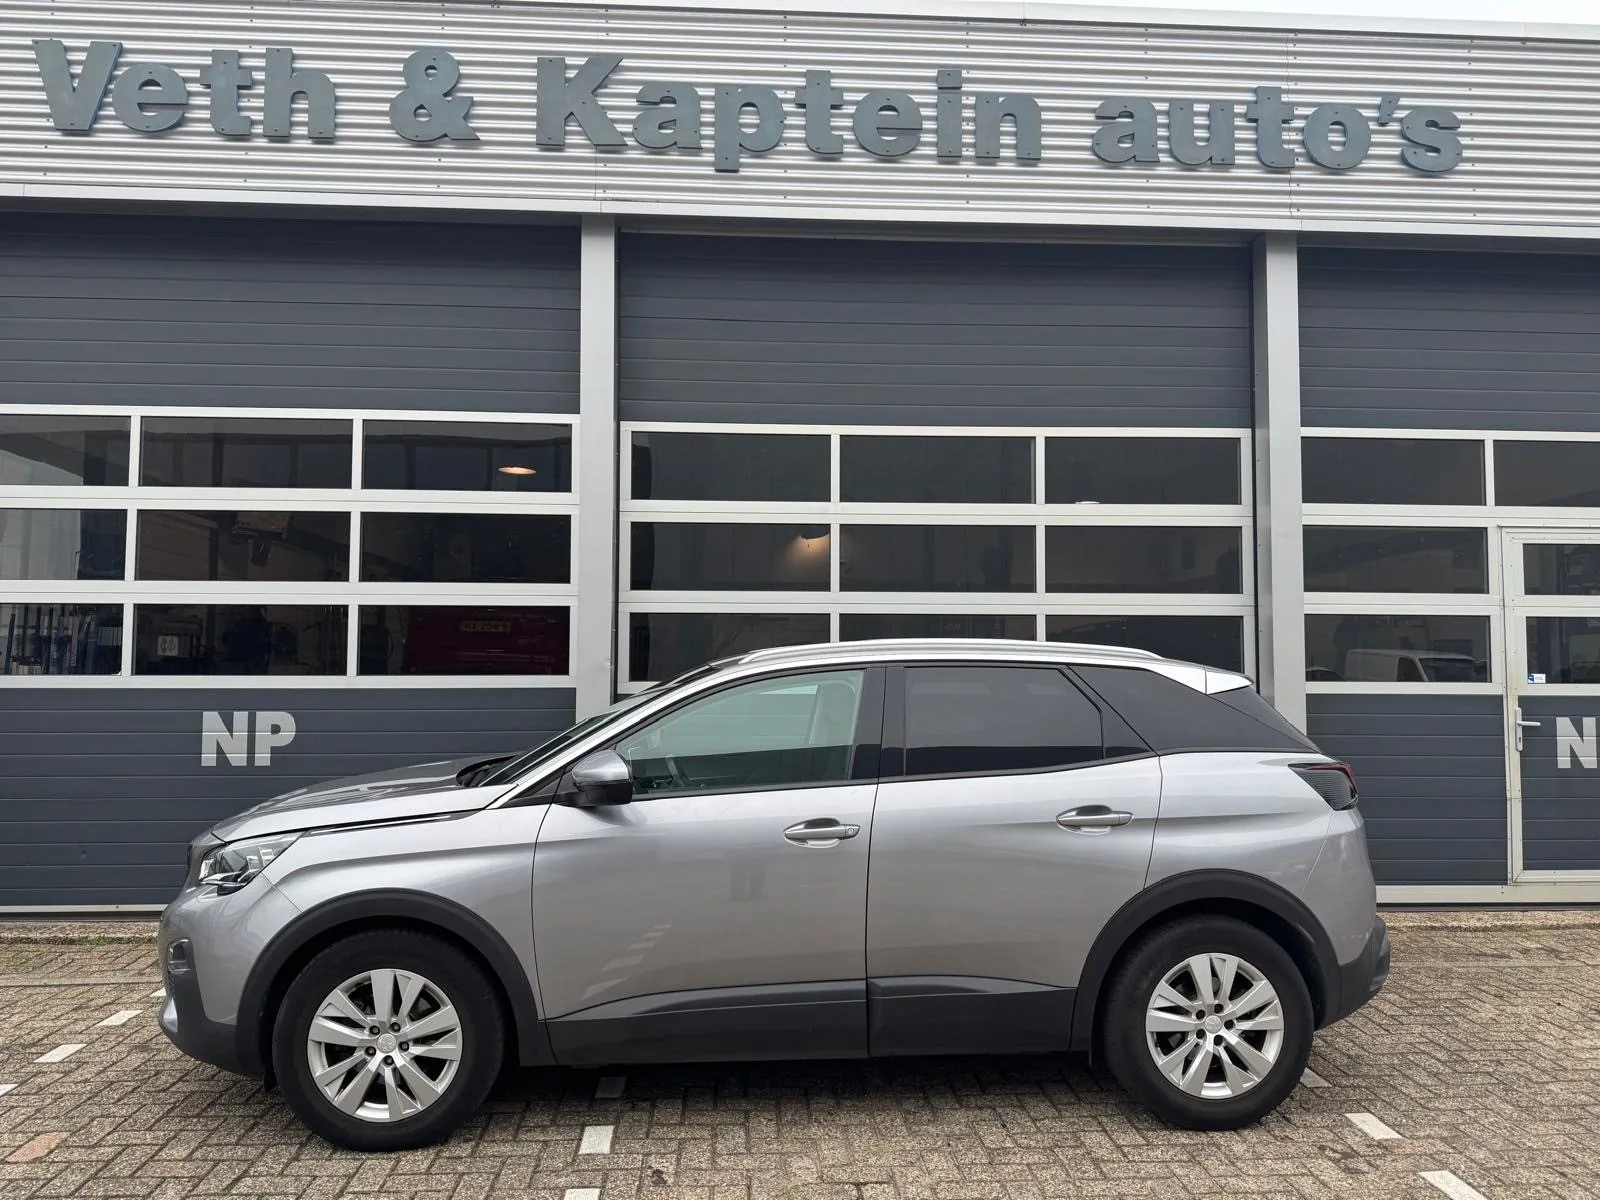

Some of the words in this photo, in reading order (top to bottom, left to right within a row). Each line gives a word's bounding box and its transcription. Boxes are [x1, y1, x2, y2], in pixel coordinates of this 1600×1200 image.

[32, 38, 336, 141] Veth
[388, 48, 481, 142] &
[535, 55, 1042, 173] Kaptein
[1091, 86, 1463, 173] auto's
[201, 711, 296, 767] NP
